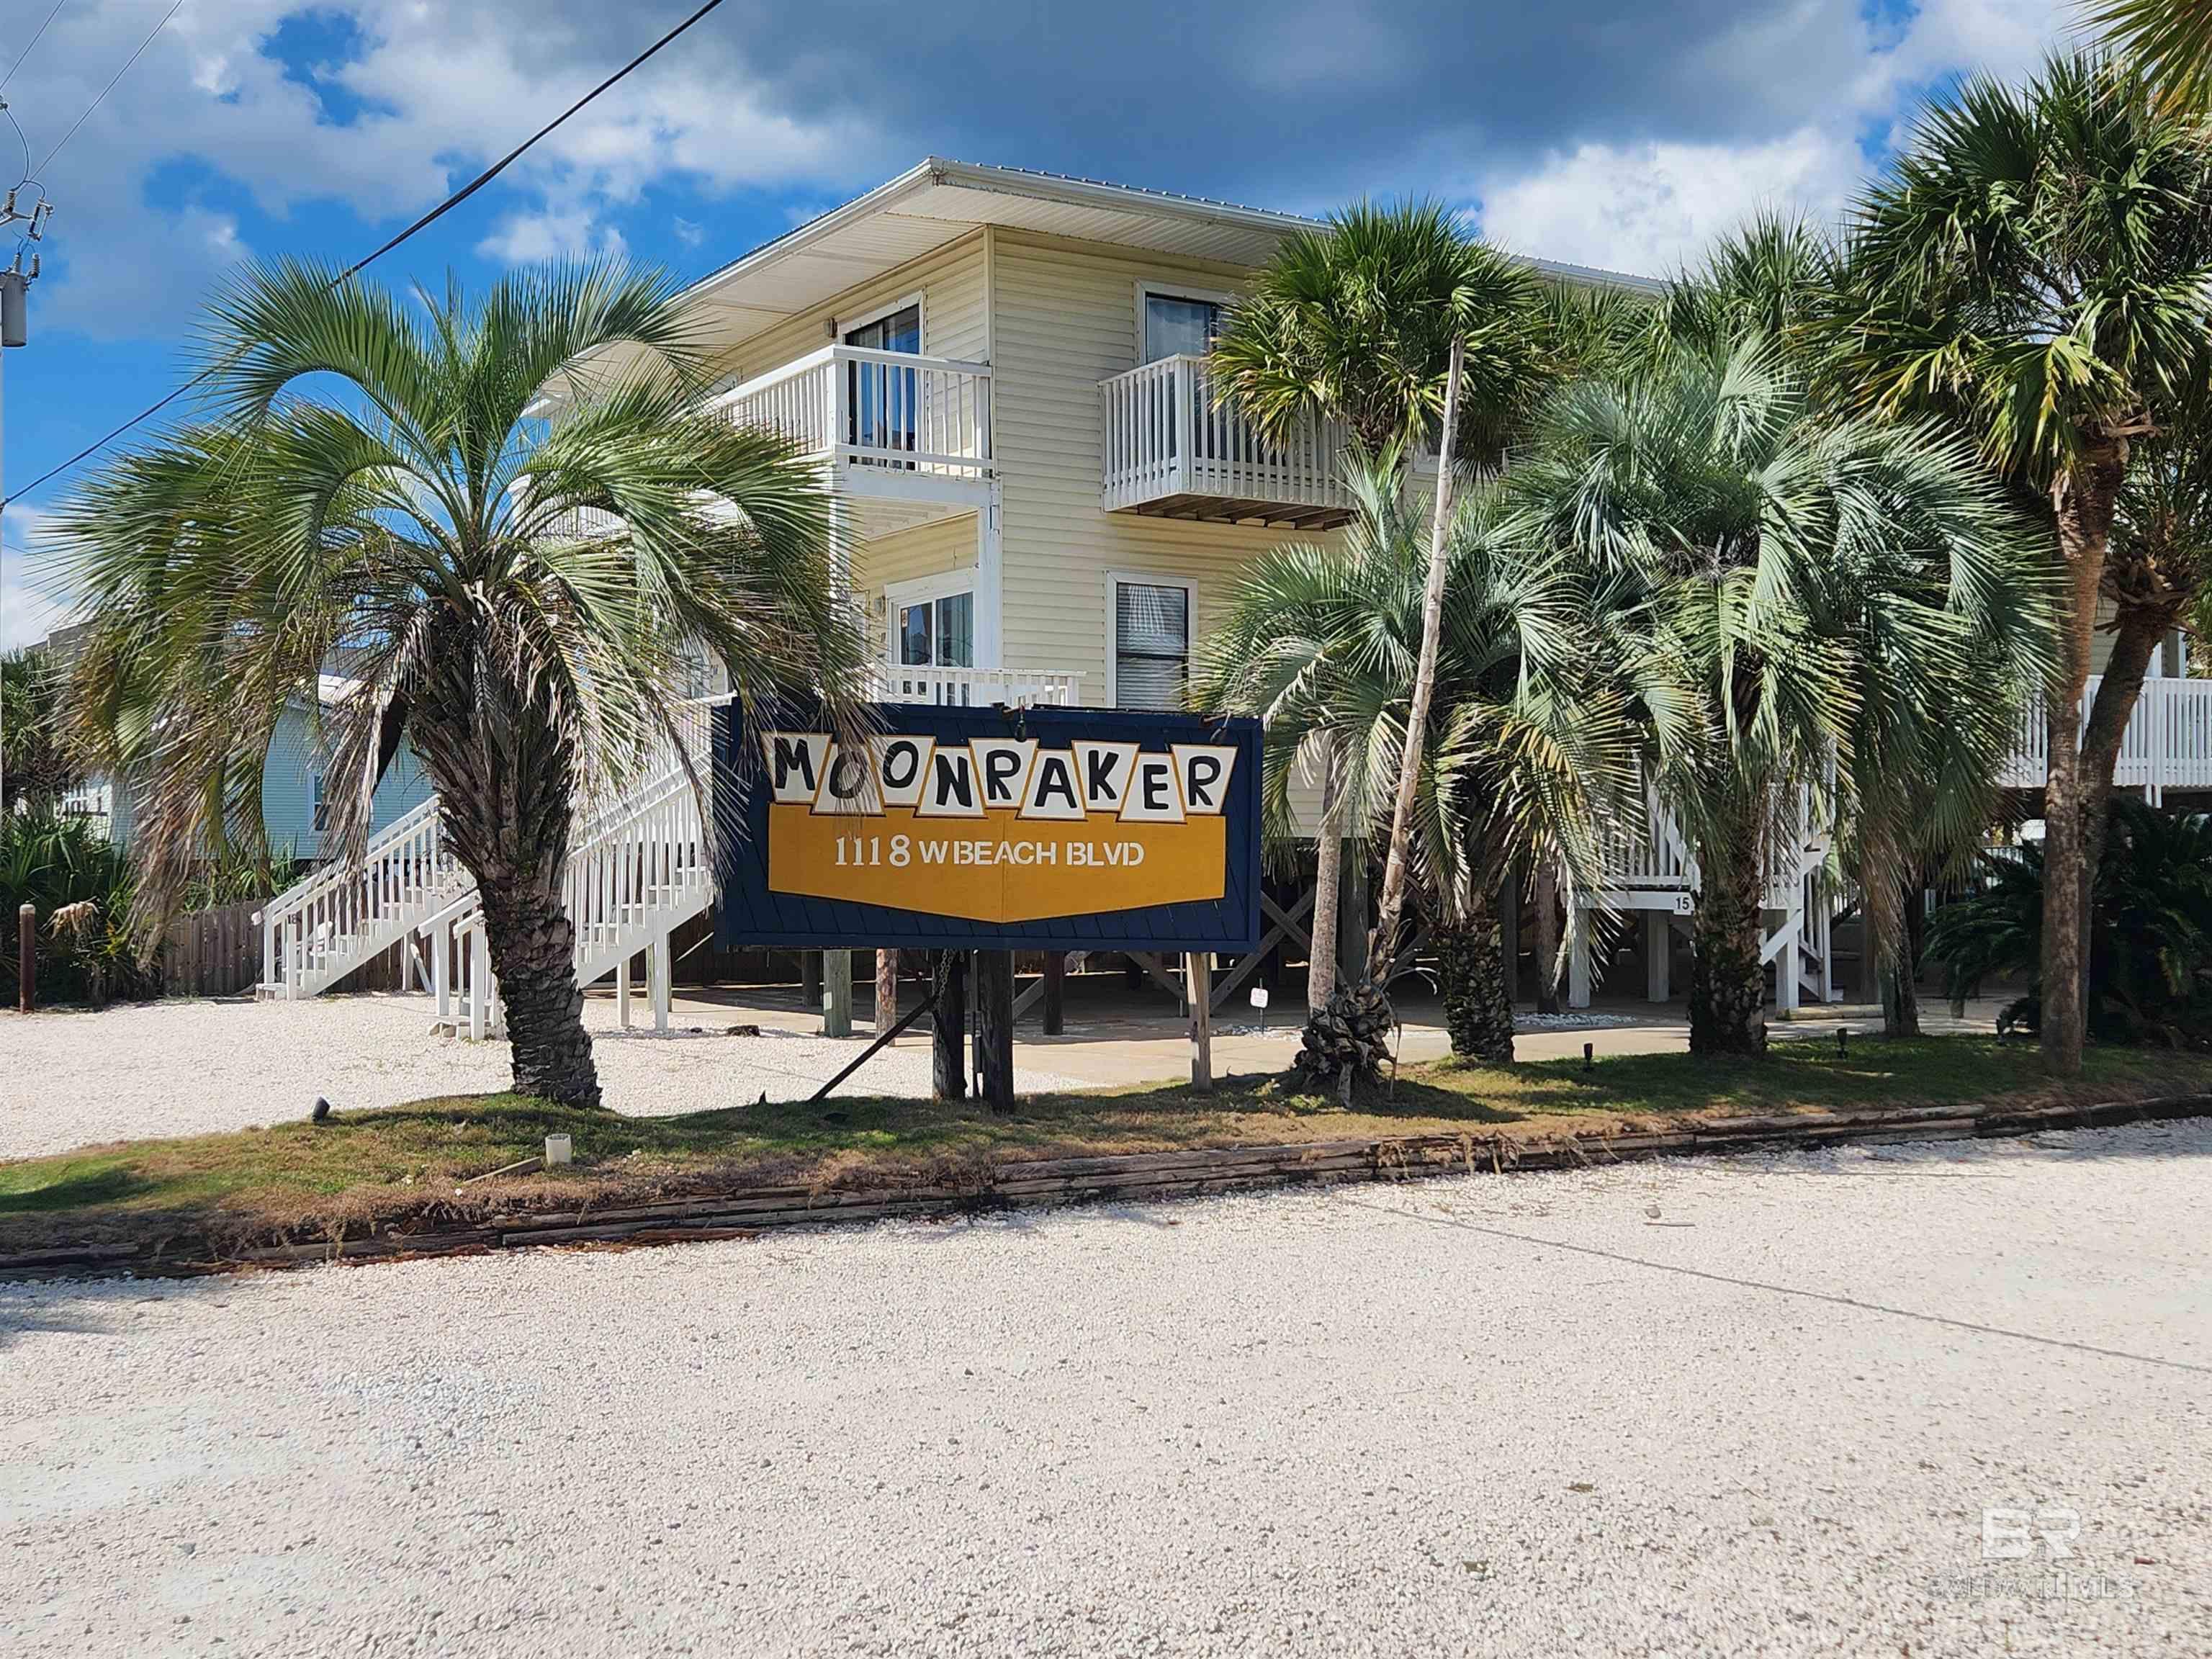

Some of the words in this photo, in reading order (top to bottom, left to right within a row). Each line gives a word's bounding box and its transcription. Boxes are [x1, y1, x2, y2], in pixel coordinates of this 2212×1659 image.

[774, 737, 1221, 810] MOONRAKER
[835, 834, 912, 867] 1118
[1066, 842, 1145, 866] BLVD
[1676, 896, 1690, 909] 15
